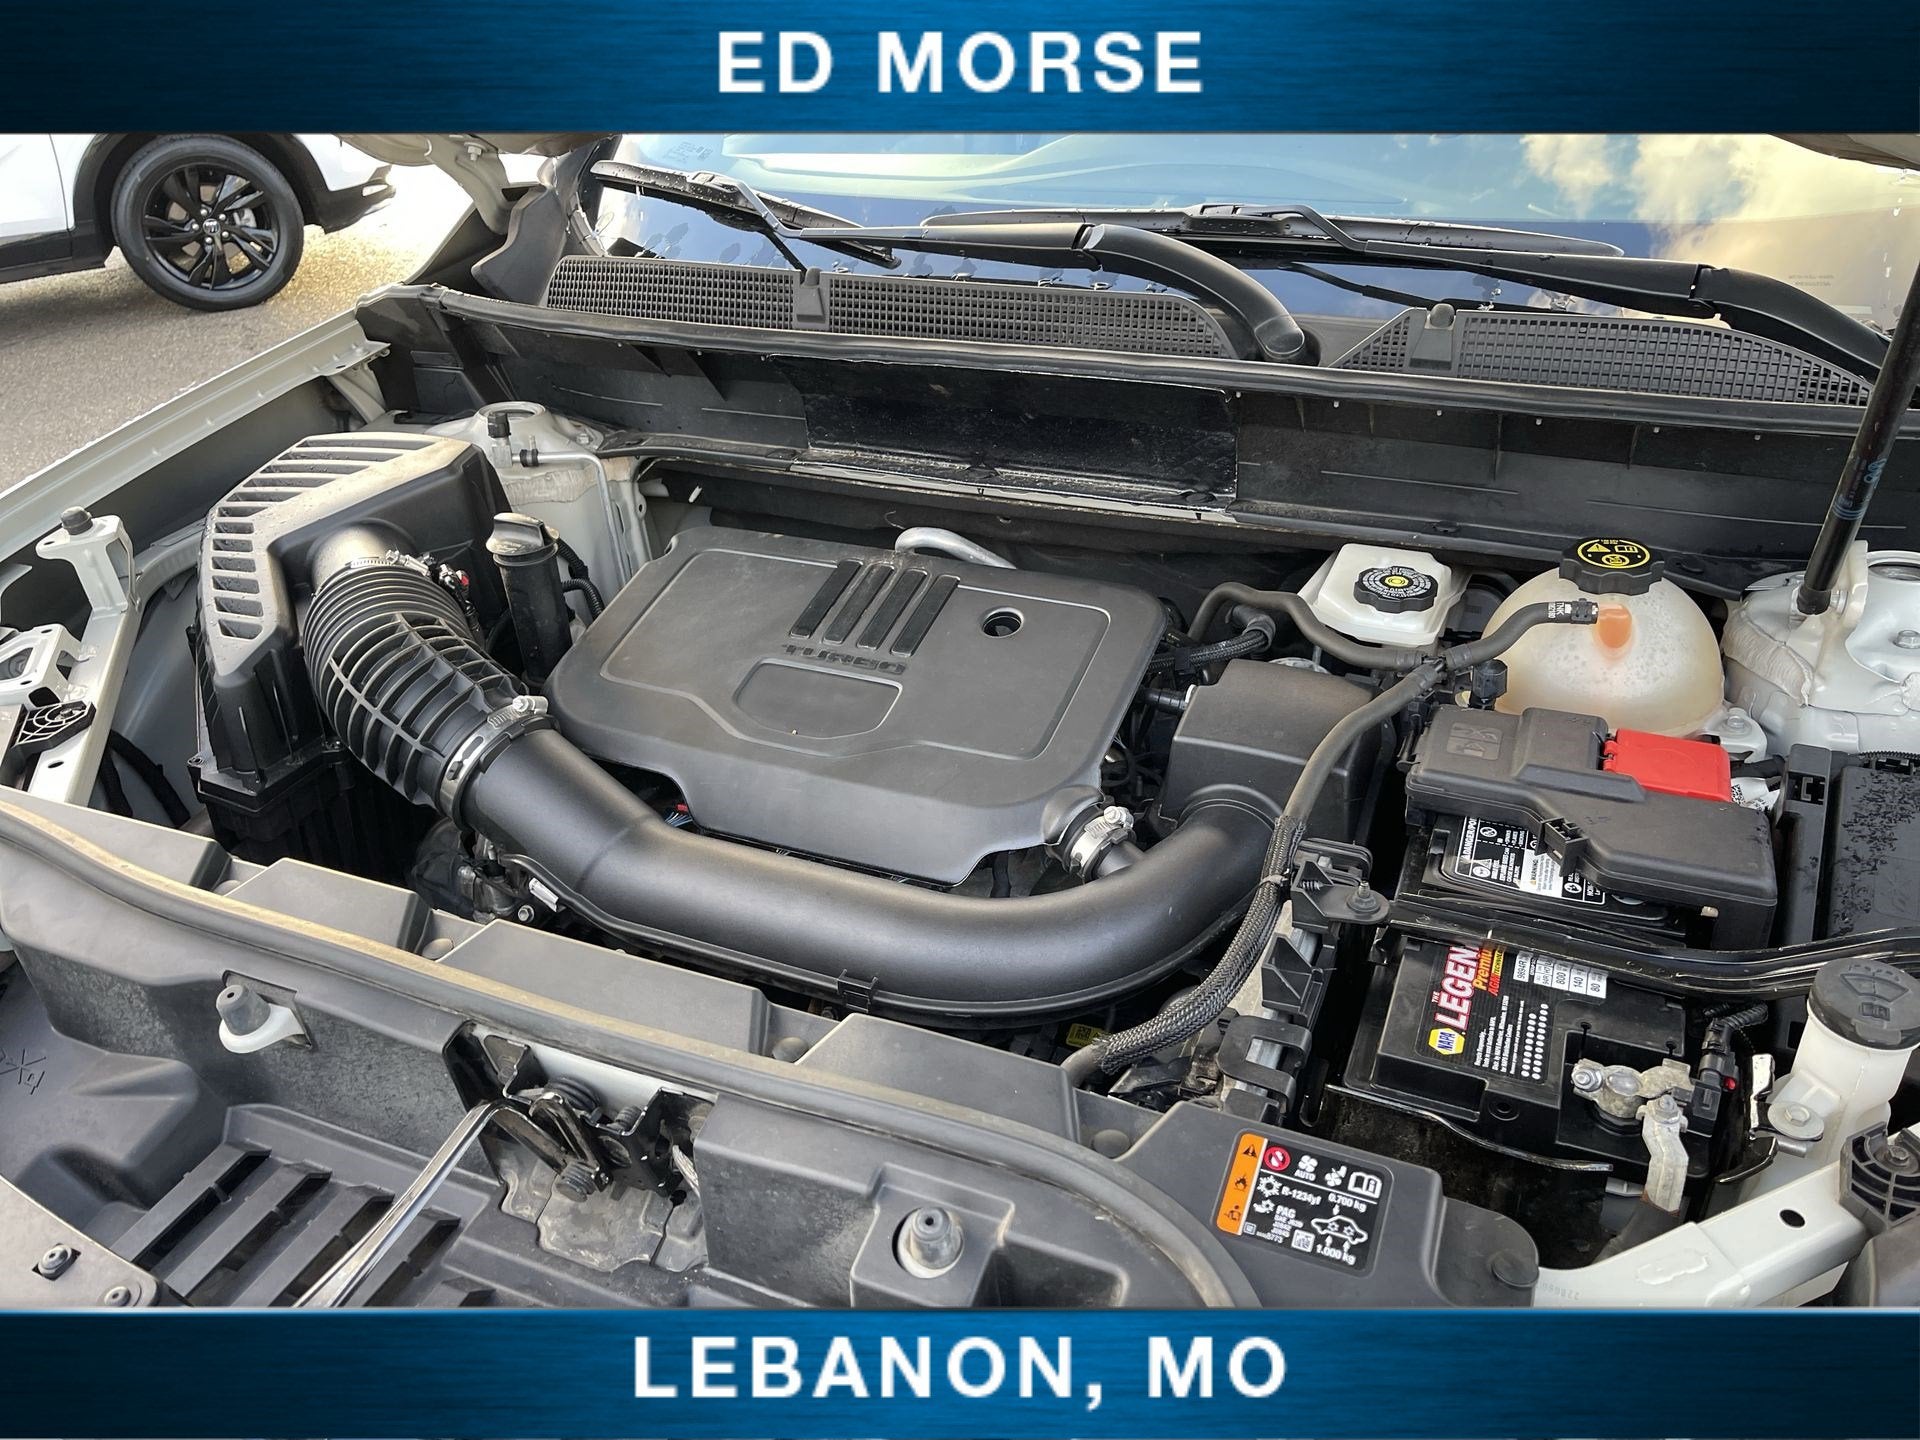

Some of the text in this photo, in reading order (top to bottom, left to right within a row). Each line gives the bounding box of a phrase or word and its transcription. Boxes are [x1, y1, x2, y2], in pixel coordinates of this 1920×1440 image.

[782, 644, 906, 675] TURBO
[1472, 947, 1493, 990] Premiu
[1488, 974, 1501, 997] AGM
[1573, 975, 1581, 988] 140
[1432, 991, 1440, 1003] THE
[1437, 1031, 1453, 1051] NAPA
[1294, 1170, 1316, 1181] AUTO
[1281, 1186, 1321, 1205] R-1234yf
[1328, 1192, 1367, 1213] 0.700 kg
[1275, 1204, 1296, 1218] PAG
[1316, 1243, 1356, 1266] 1.000 kg
